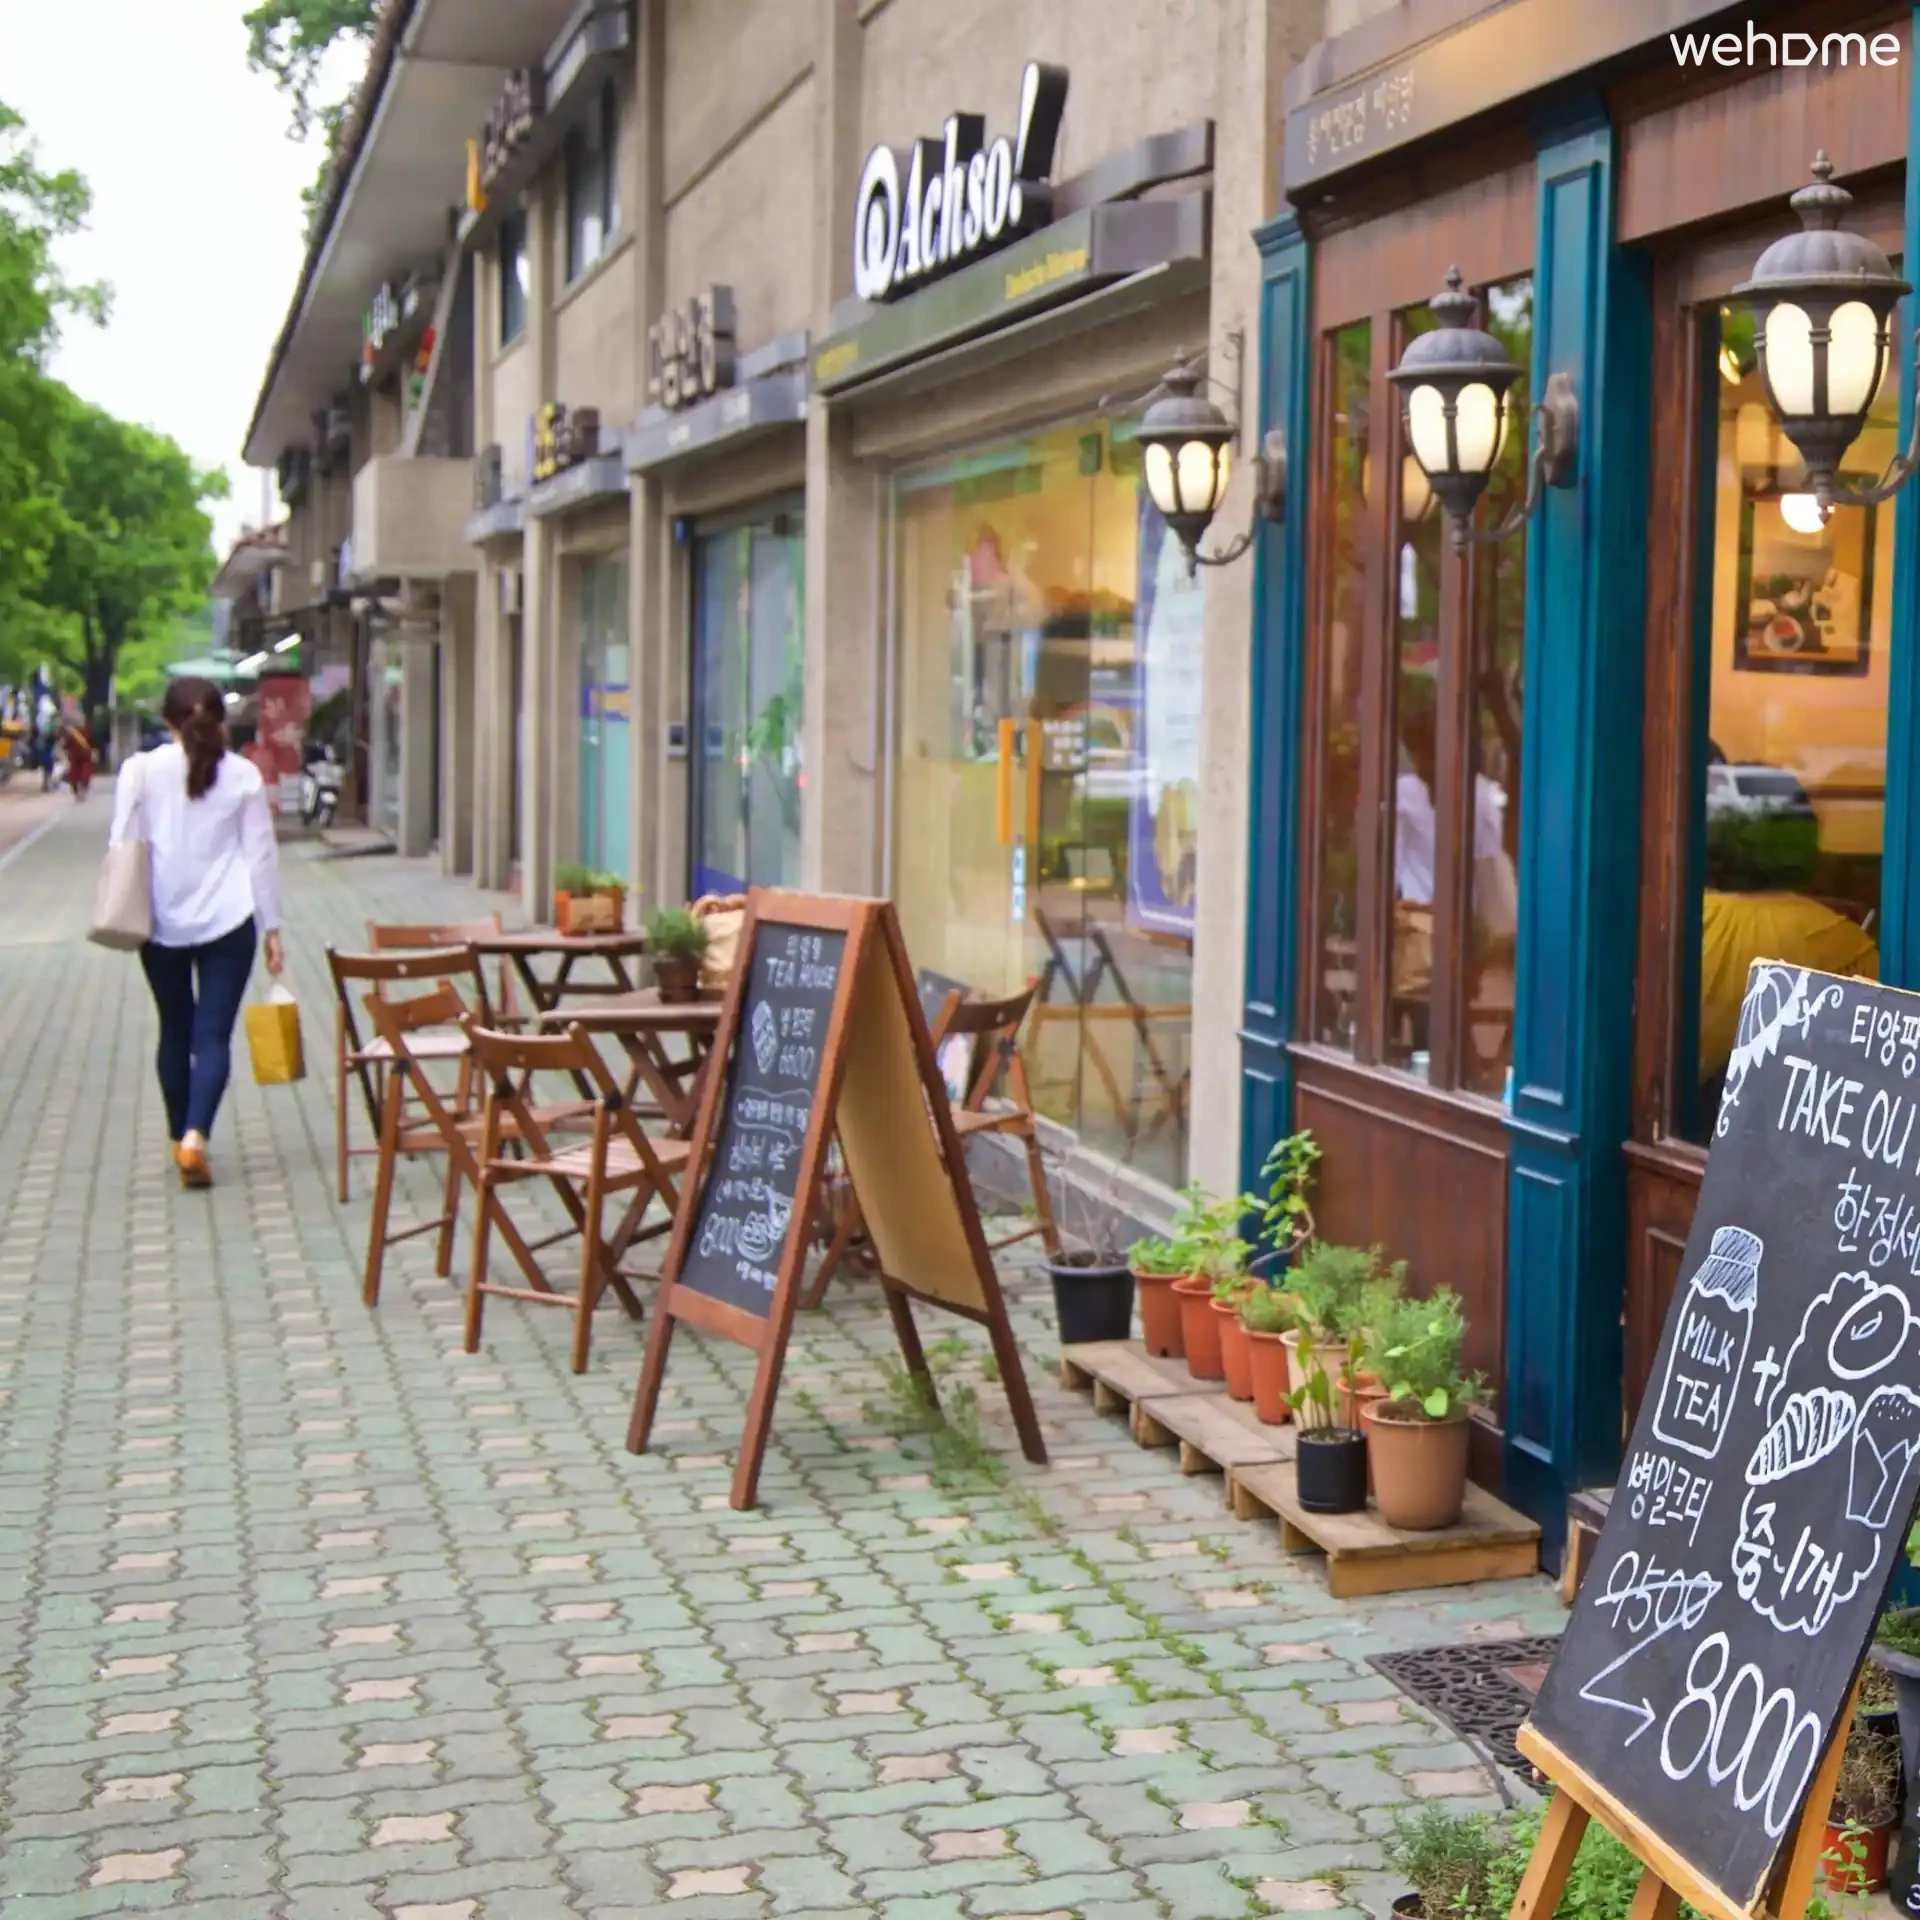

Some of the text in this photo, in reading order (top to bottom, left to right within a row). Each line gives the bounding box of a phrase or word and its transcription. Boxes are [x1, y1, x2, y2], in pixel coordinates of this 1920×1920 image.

[766, 957, 796, 988] TEA
[1777, 1054, 1920, 1176] TAKE OU
[1682, 1311, 1735, 1374] MILK
[1673, 1374, 1722, 1432] TEA
[1605, 1551, 1716, 1634] 9500
[1659, 1630, 1822, 1848] 8000
